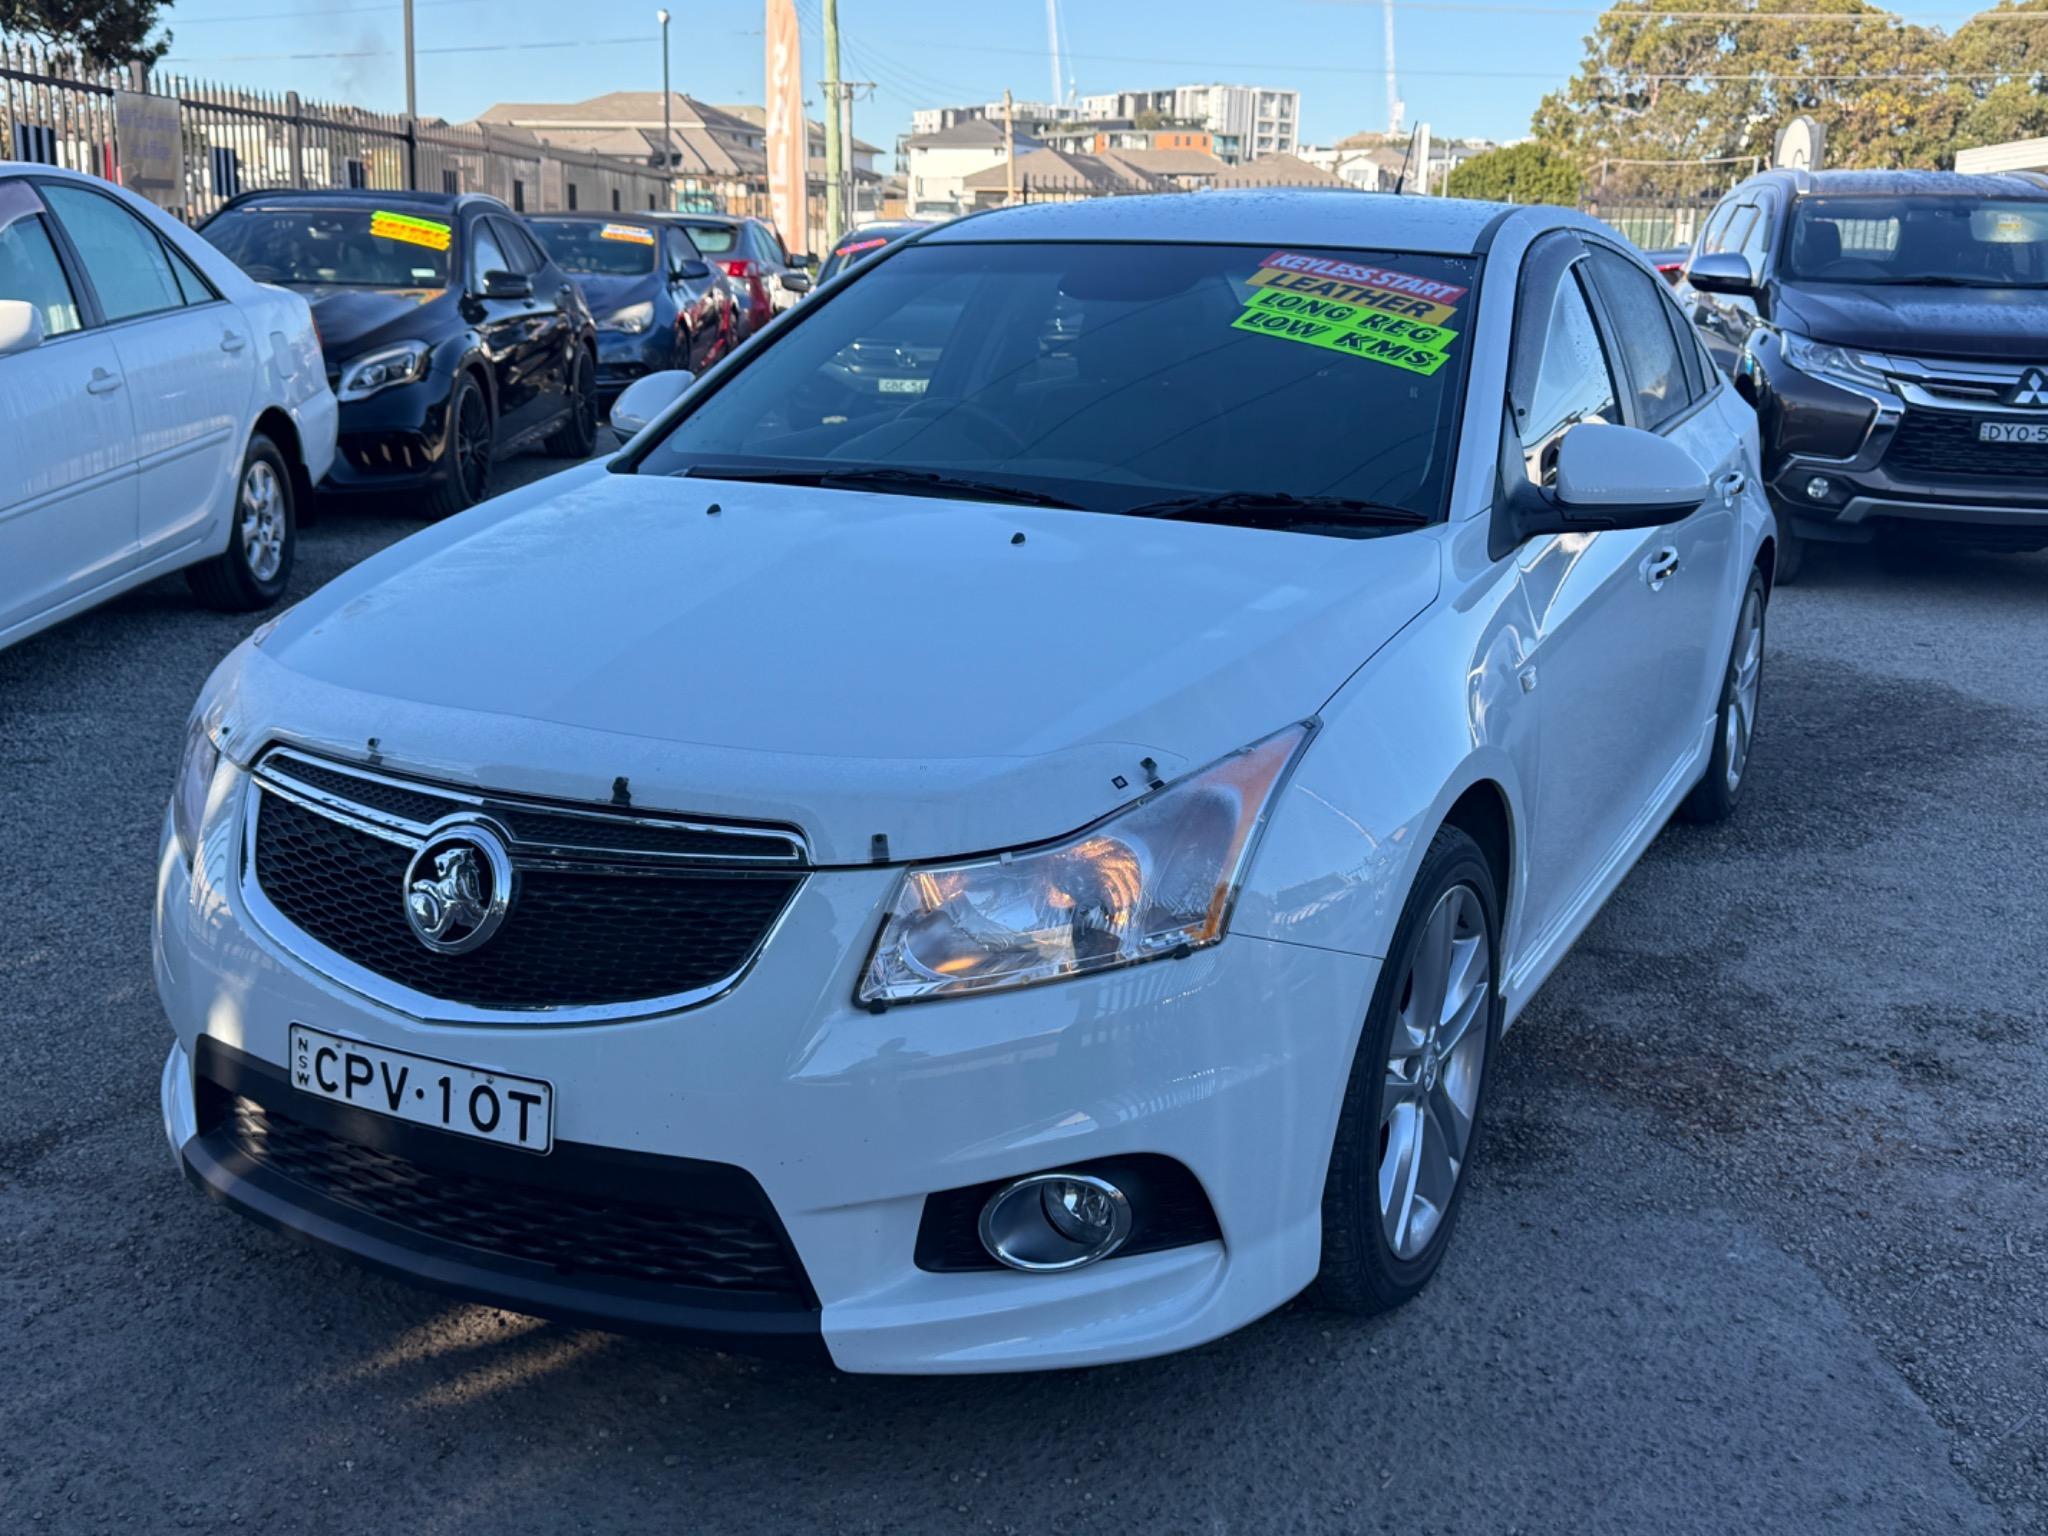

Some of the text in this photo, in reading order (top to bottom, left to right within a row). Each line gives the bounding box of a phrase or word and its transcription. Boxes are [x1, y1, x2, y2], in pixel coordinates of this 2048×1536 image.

[1265, 273, 1436, 318] LEATHER
[1270, 254, 1460, 298] KEYLESS START
[1243, 312, 1439, 367] LOW KMS
[1258, 292, 1442, 343] LONG REG
